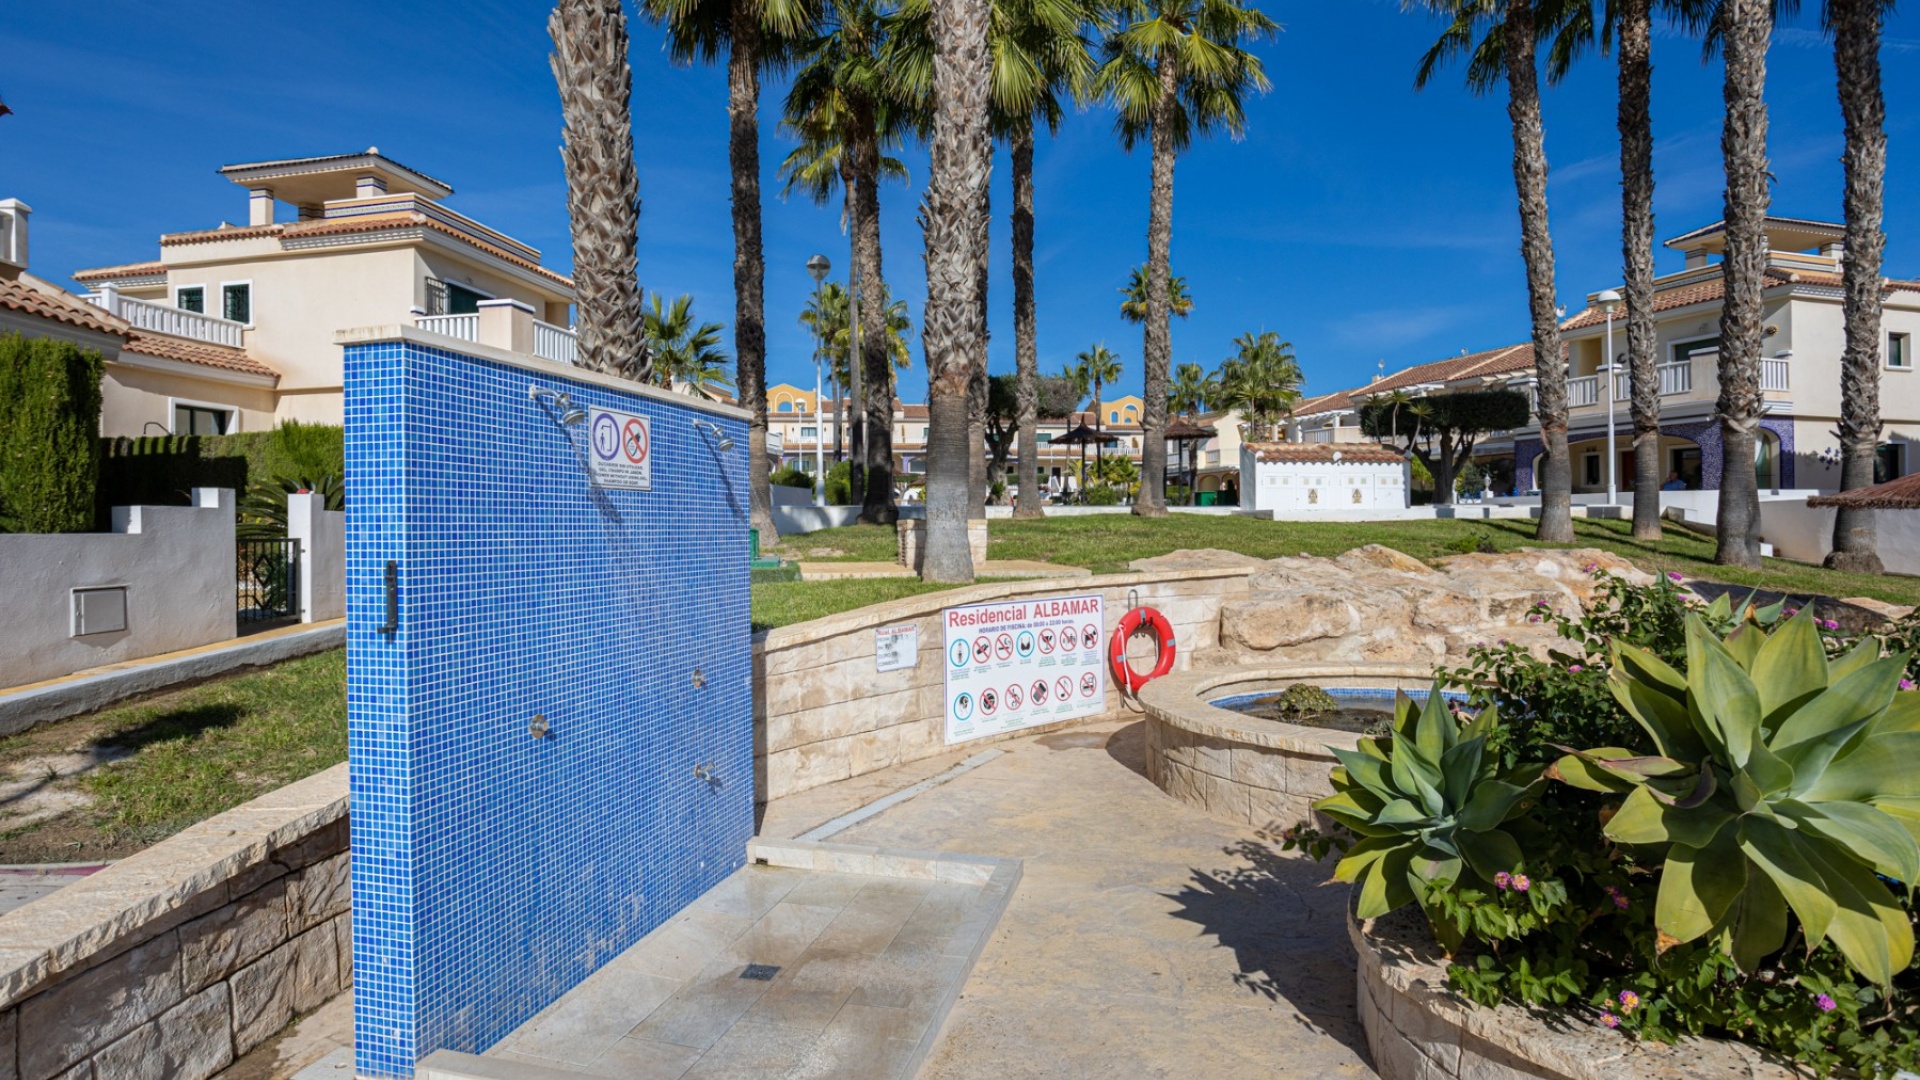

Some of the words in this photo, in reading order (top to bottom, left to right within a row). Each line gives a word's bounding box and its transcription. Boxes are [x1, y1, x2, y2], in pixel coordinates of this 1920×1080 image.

[949, 605, 1027, 628] Residencial
[1033, 599, 1099, 618] ALBAMAR
[978, 626, 1000, 634] HORARIO
